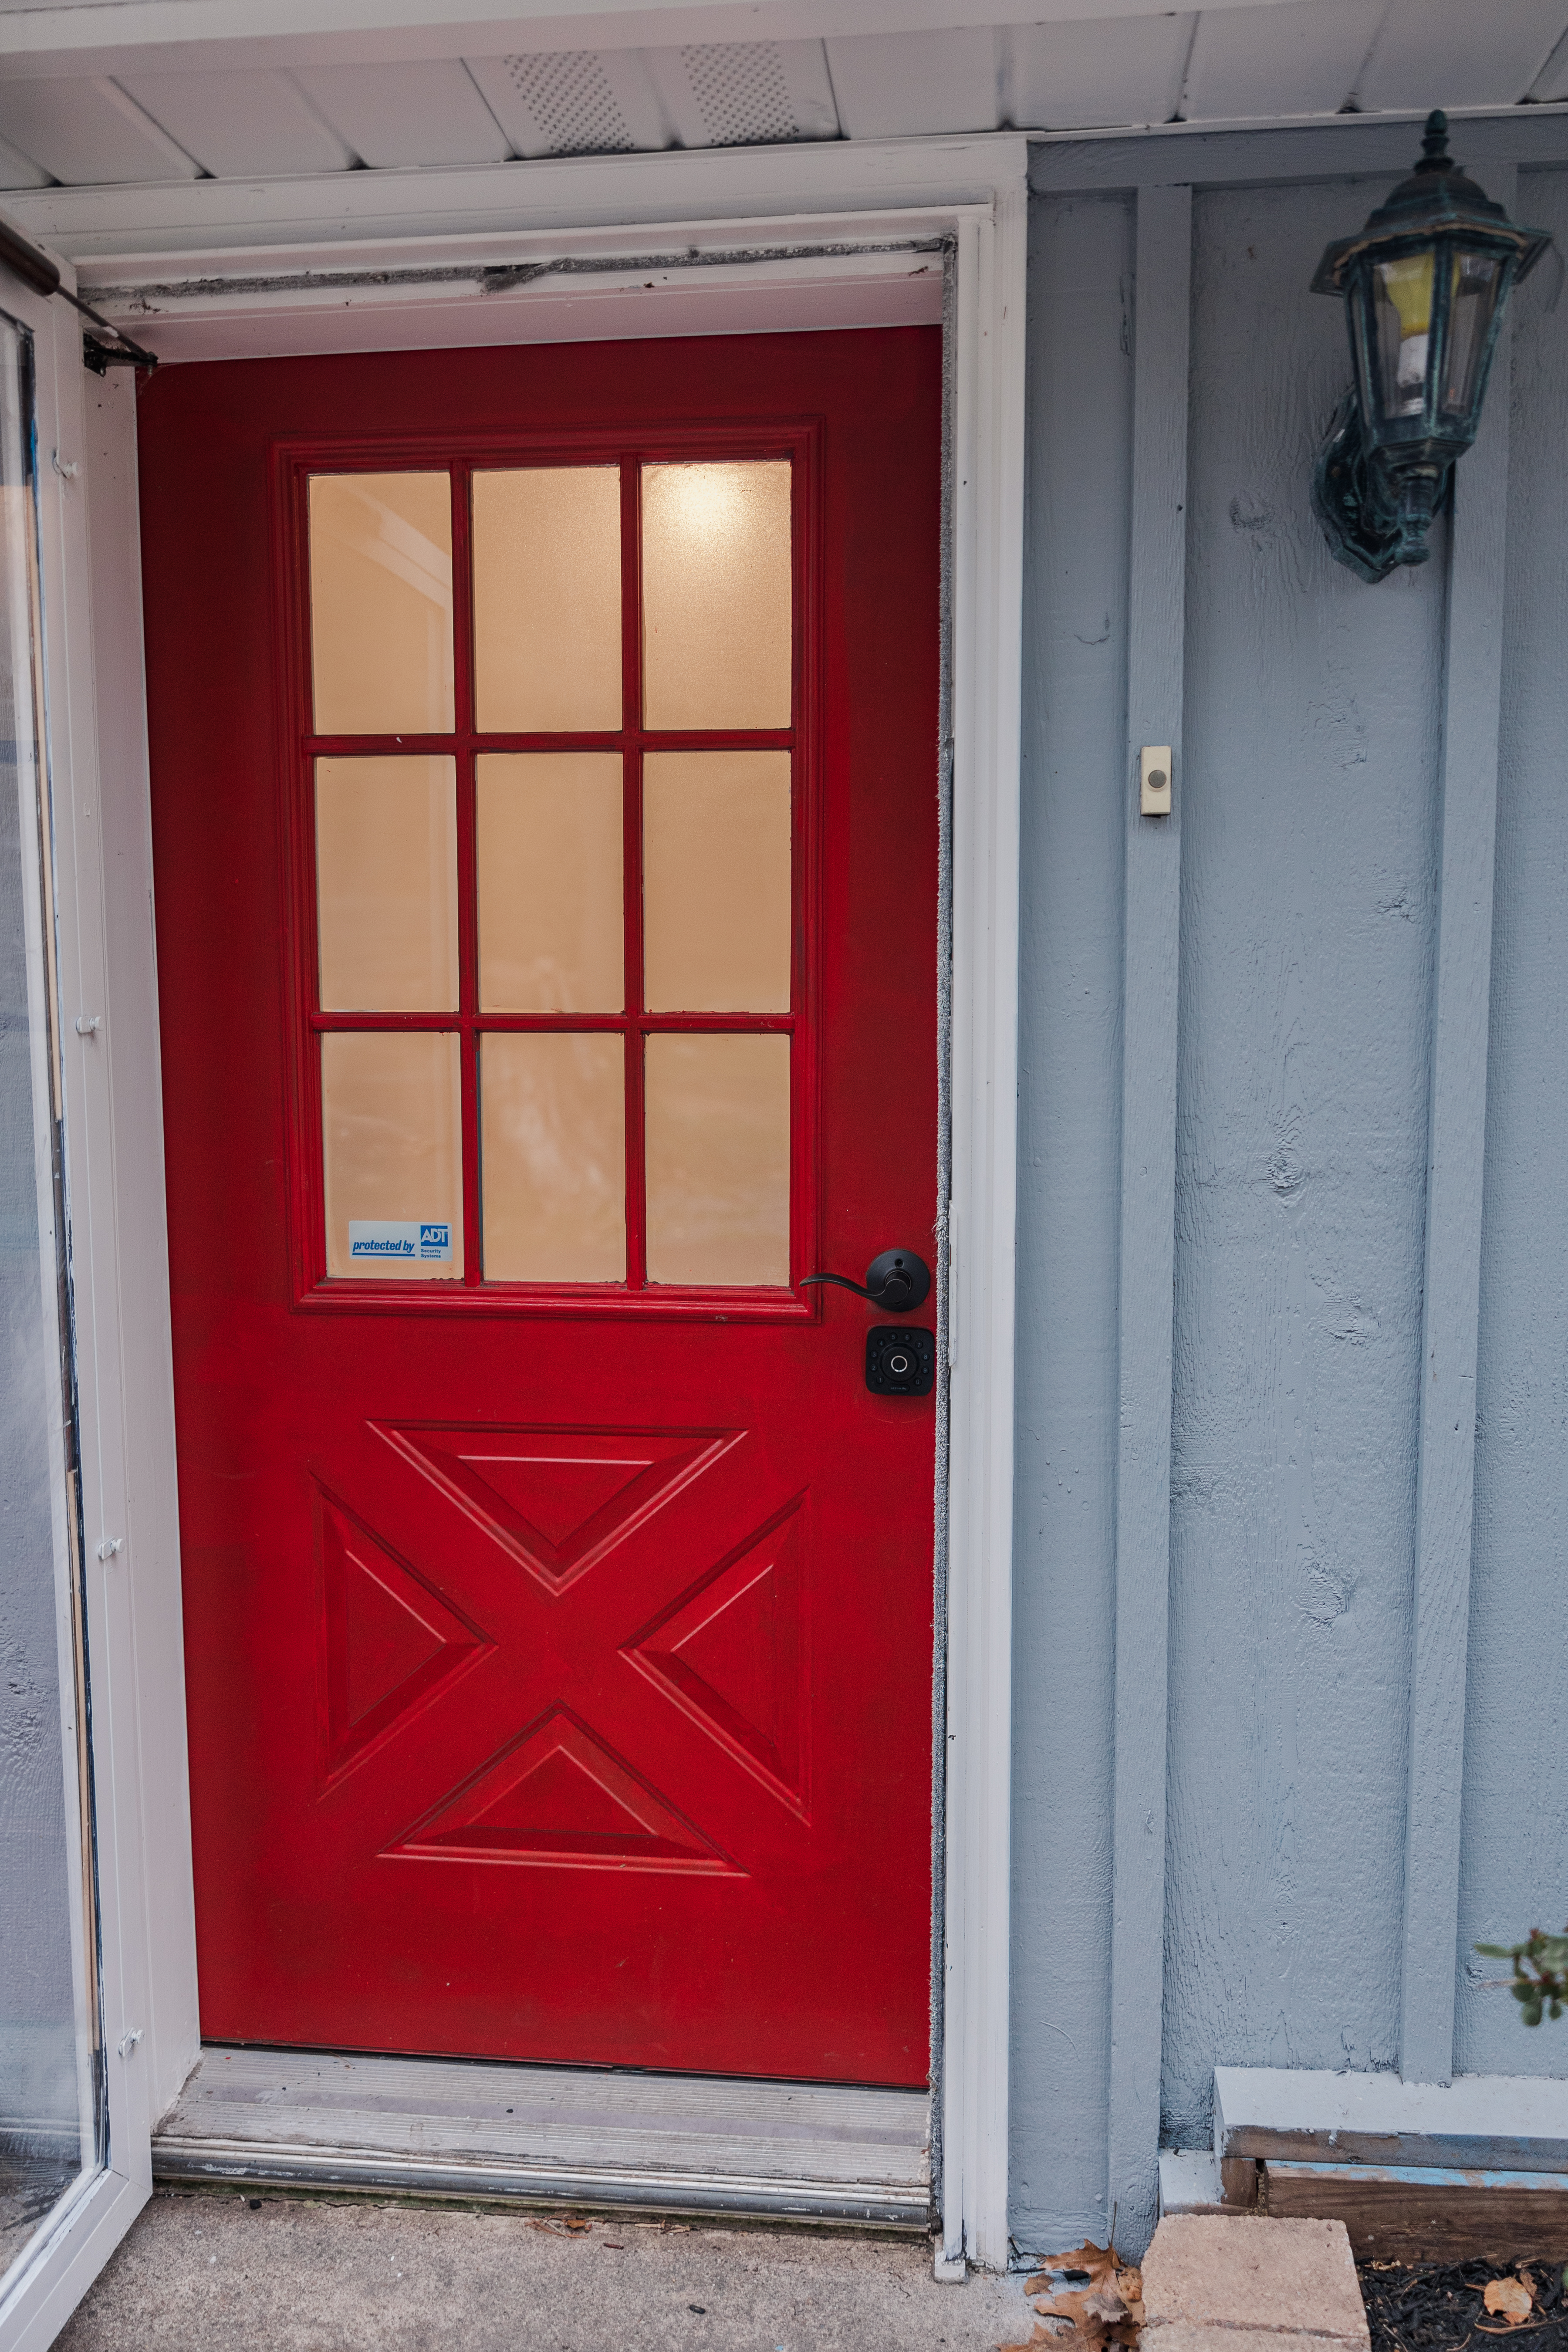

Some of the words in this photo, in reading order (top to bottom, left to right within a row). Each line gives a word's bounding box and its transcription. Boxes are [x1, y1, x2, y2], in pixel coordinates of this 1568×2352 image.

[421, 1228, 448, 1242] ADT
[353, 1240, 402, 1252] protected
[403, 1240, 415, 1253] by
